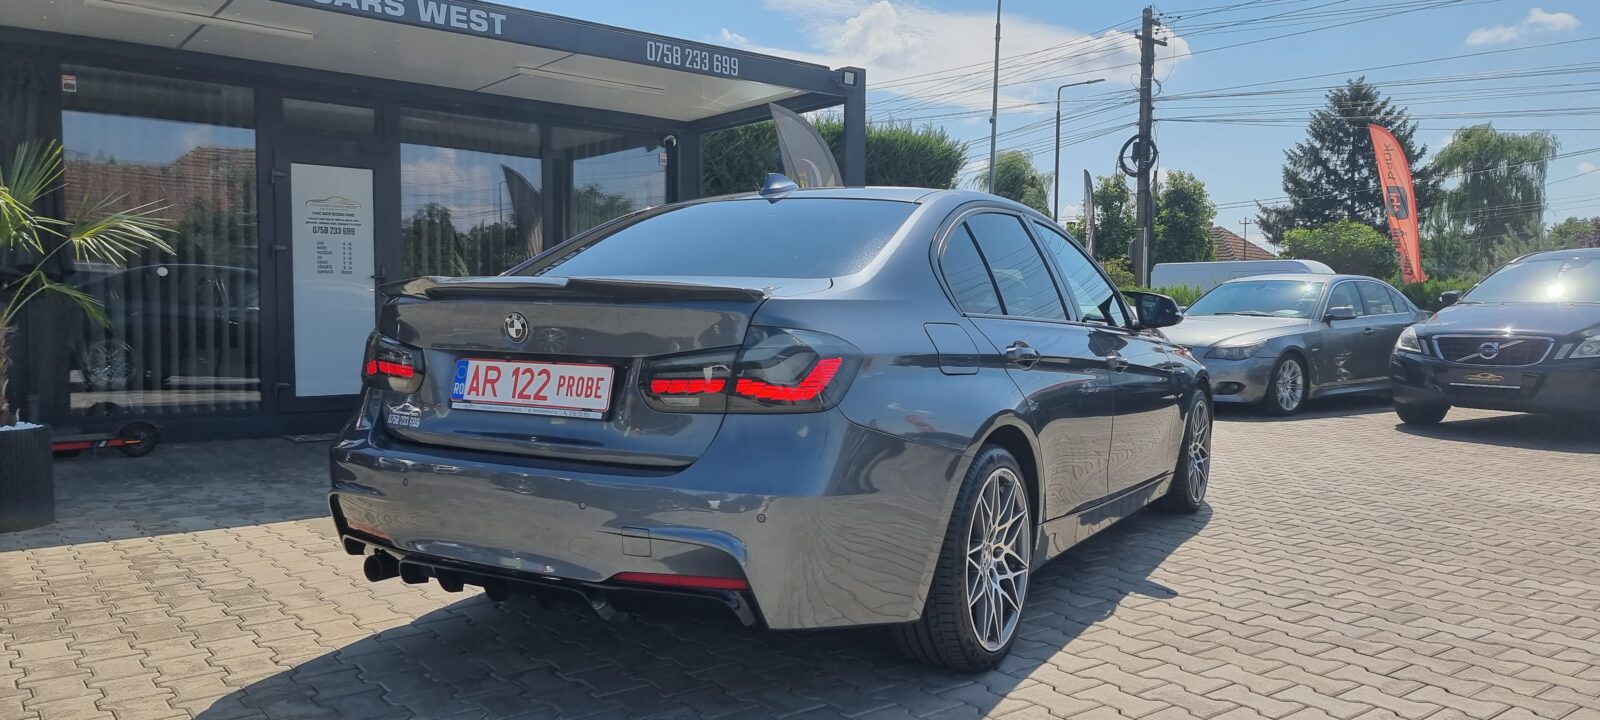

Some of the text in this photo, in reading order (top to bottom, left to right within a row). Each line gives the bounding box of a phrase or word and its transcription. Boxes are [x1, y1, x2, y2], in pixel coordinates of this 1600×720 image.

[314, 0, 507, 35] RS WEST
[646, 40, 739, 77] 0758 233 699
[312, 226, 356, 236] 0758 233 699
[453, 382, 465, 395] RO
[467, 364, 605, 401] AR 122 PROBE
